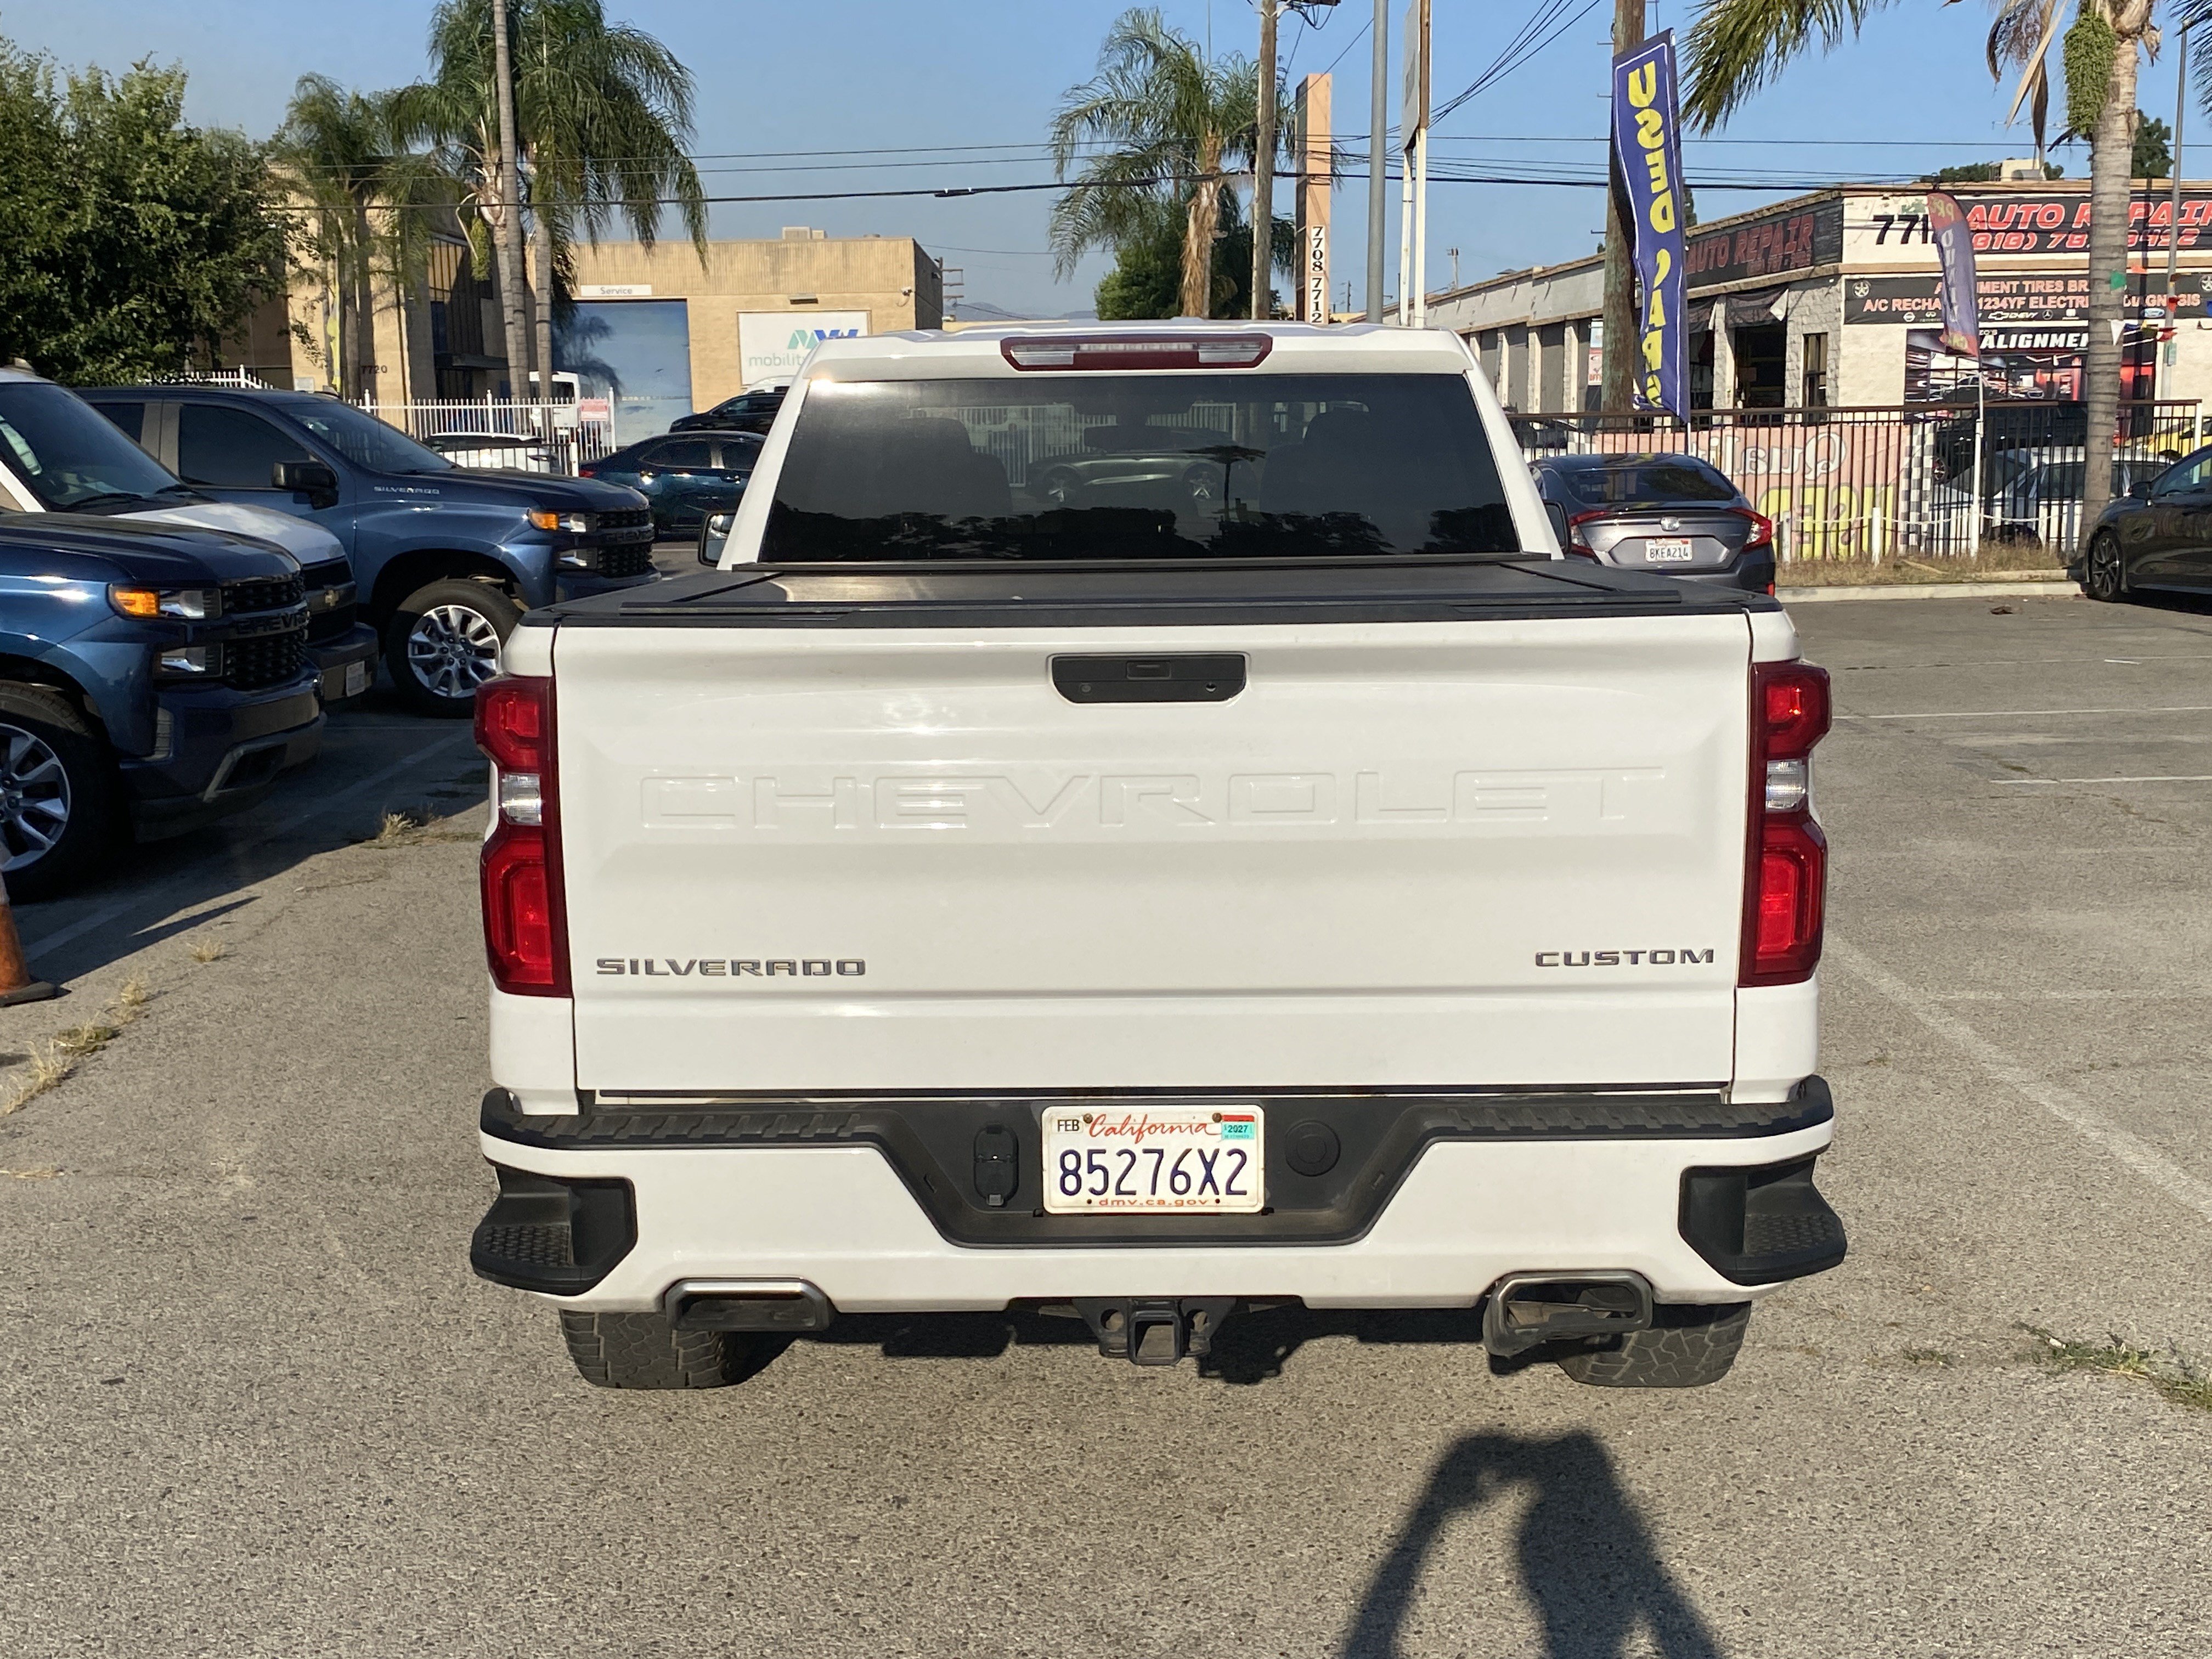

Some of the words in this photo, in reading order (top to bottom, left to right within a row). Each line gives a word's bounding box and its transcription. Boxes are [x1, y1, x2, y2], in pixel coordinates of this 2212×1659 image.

[1966, 203, 2065, 230] AUTO
[2072, 200, 2212, 230] RPAI
[1872, 214, 1937, 245] 771
[1312, 226, 1323, 272] 7708
[1686, 235, 1730, 275] AUTO
[1733, 213, 1814, 265] REPAIR
[1971, 232, 2038, 250] 818)
[600, 286, 633, 295] Service
[2022, 279, 2064, 294] TIRES
[1312, 278, 1322, 323] 7712
[1863, 299, 1888, 312] A/C
[1892, 297, 1942, 312] RECHA
[749, 353, 804, 367] mobilit
[362, 365, 387, 374] 7720
[374, 486, 439, 494] SILVERADO
[640, 766, 1666, 830] CHEVROLET
[1535, 948, 1714, 967] CUSTOM
[596, 958, 866, 977] SILVERADO
[1057, 1119, 1080, 1132] FEB
[1088, 1114, 1222, 1144] California
[1227, 1125, 1248, 1133] 2027
[1059, 1148, 1248, 1196] 85276X2
[1098, 1198, 1209, 1206] dmv.ca.gov
